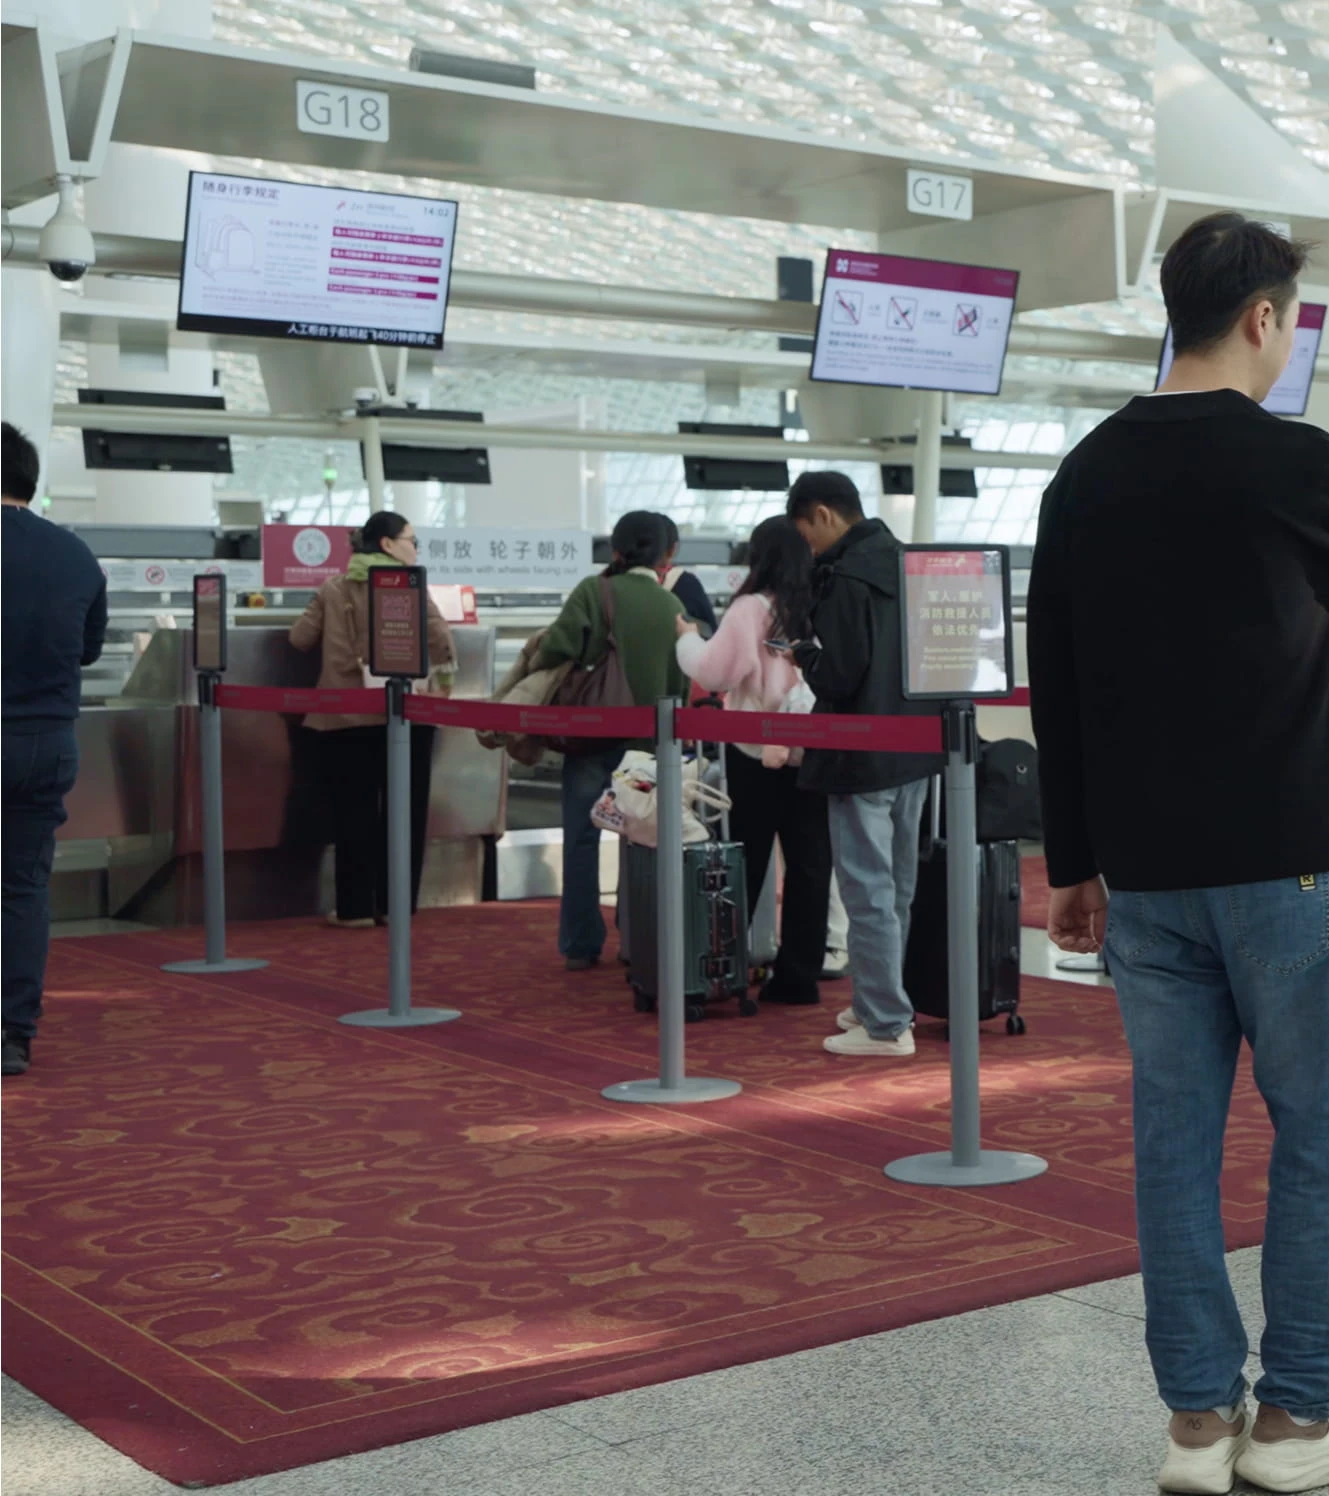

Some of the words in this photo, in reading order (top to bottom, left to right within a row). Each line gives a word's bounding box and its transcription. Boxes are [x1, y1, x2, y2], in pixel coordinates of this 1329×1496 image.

[303, 90, 382, 132] G18
[912, 177, 967, 211] G17
[489, 539, 579, 560] 轮子朝外
